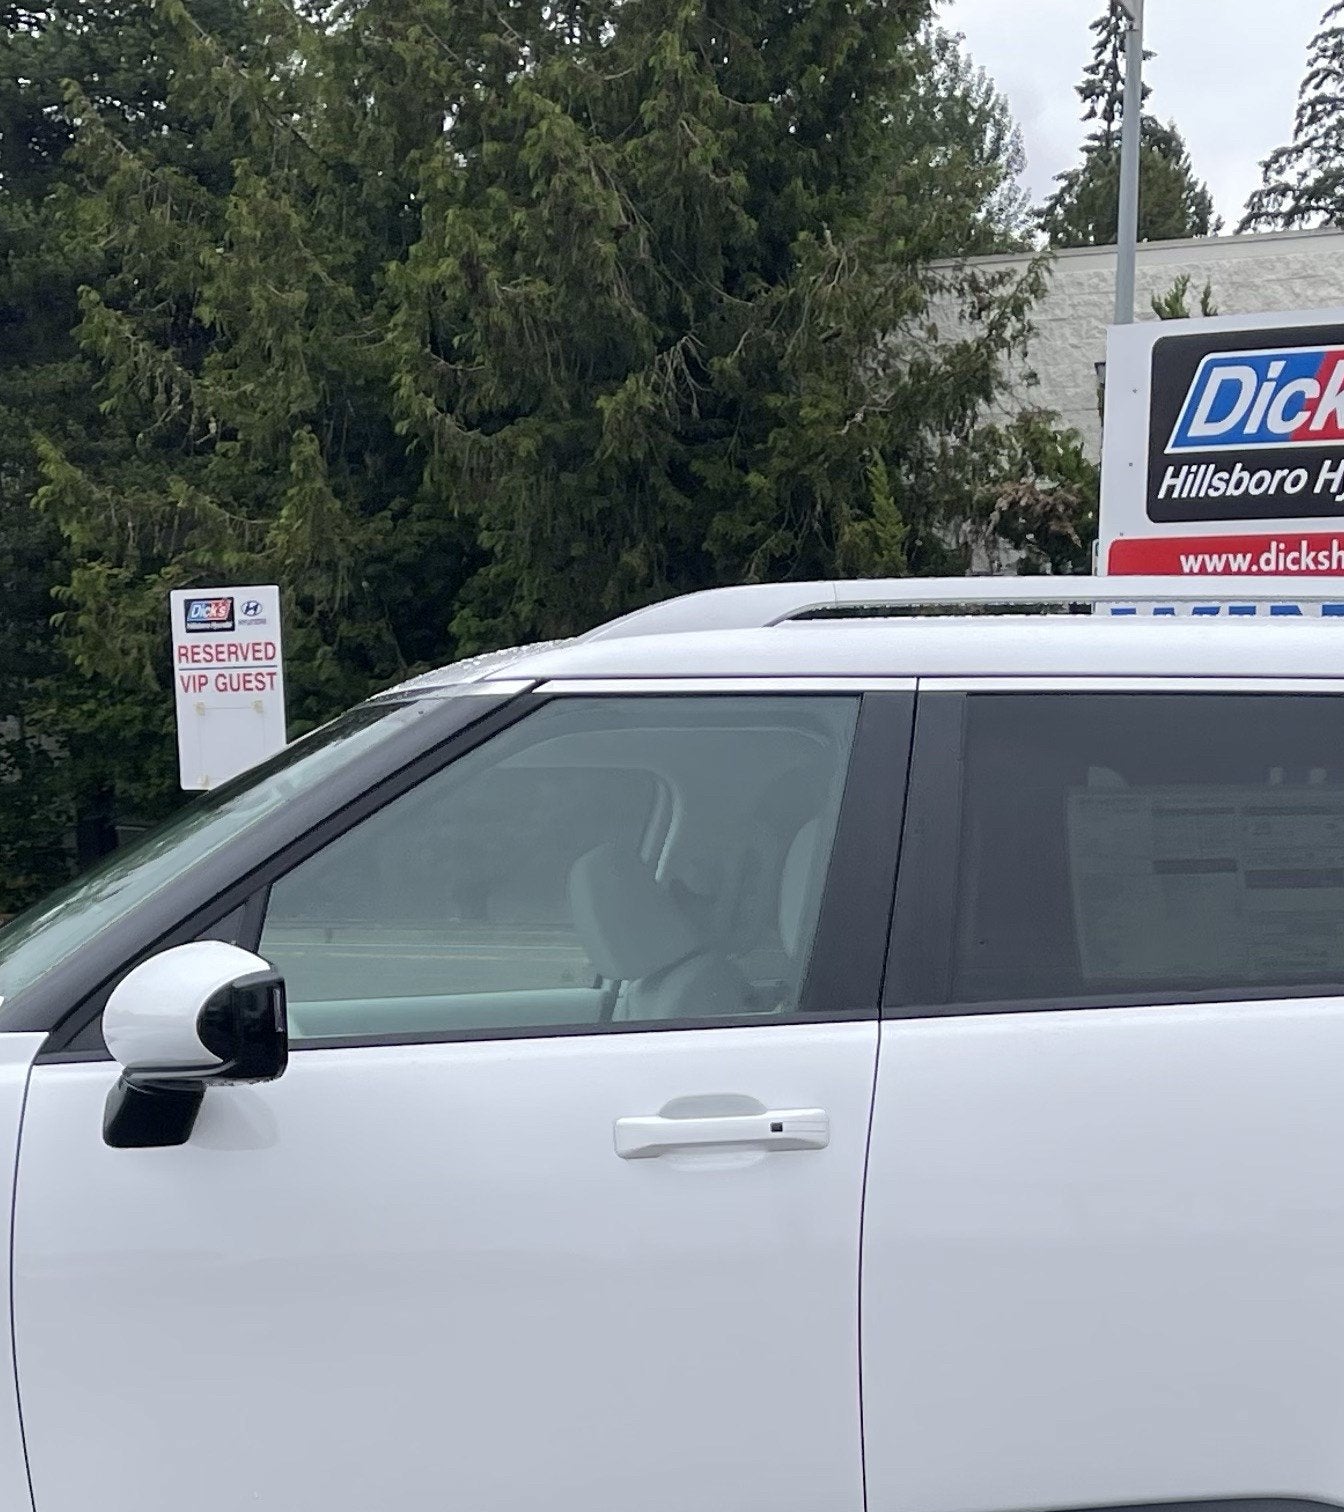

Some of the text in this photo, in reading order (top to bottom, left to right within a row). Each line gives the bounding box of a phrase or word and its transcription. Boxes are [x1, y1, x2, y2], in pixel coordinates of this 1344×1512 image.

[1157, 460, 1309, 499] Hillsboro
[177, 641, 277, 664] RESERVED
[180, 671, 277, 694] VIP GUEST
